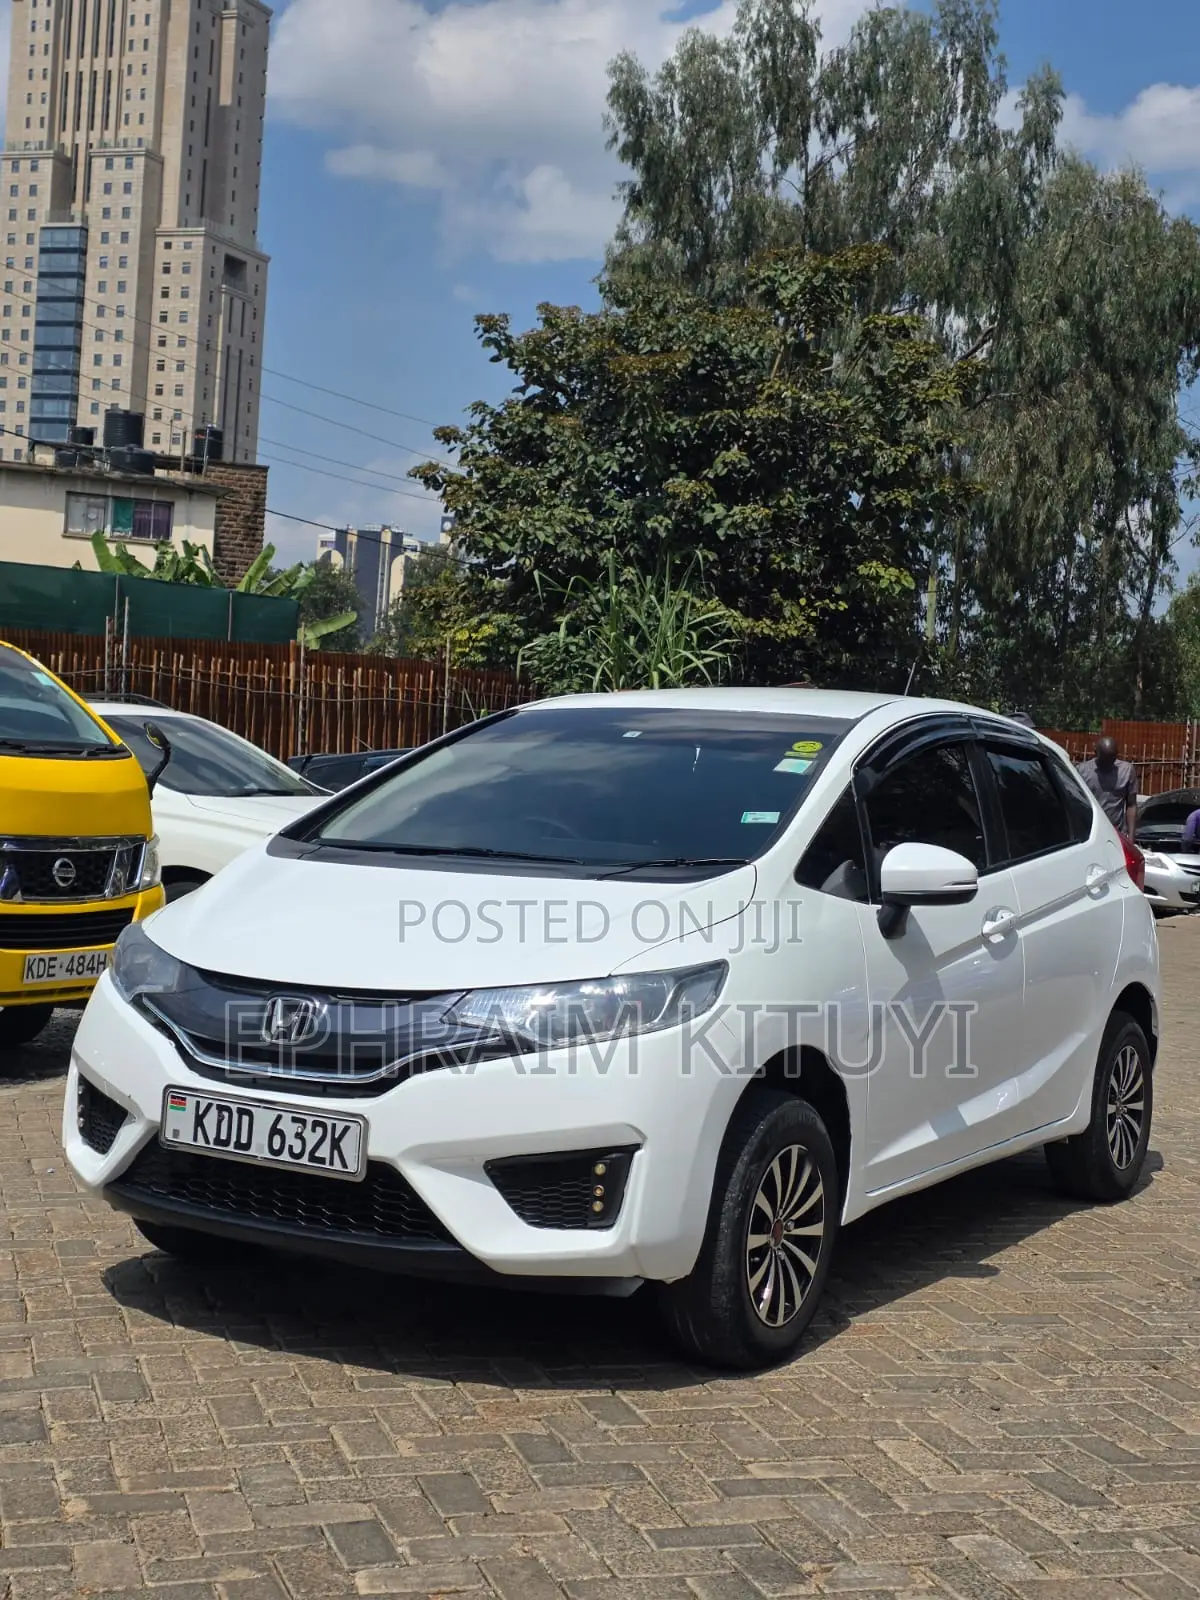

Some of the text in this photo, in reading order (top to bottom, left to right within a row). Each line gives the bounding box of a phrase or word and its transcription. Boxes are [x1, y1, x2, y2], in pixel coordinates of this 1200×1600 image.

[25, 953, 107, 980] KDE 484H
[193, 1100, 351, 1169] KDD 632K
